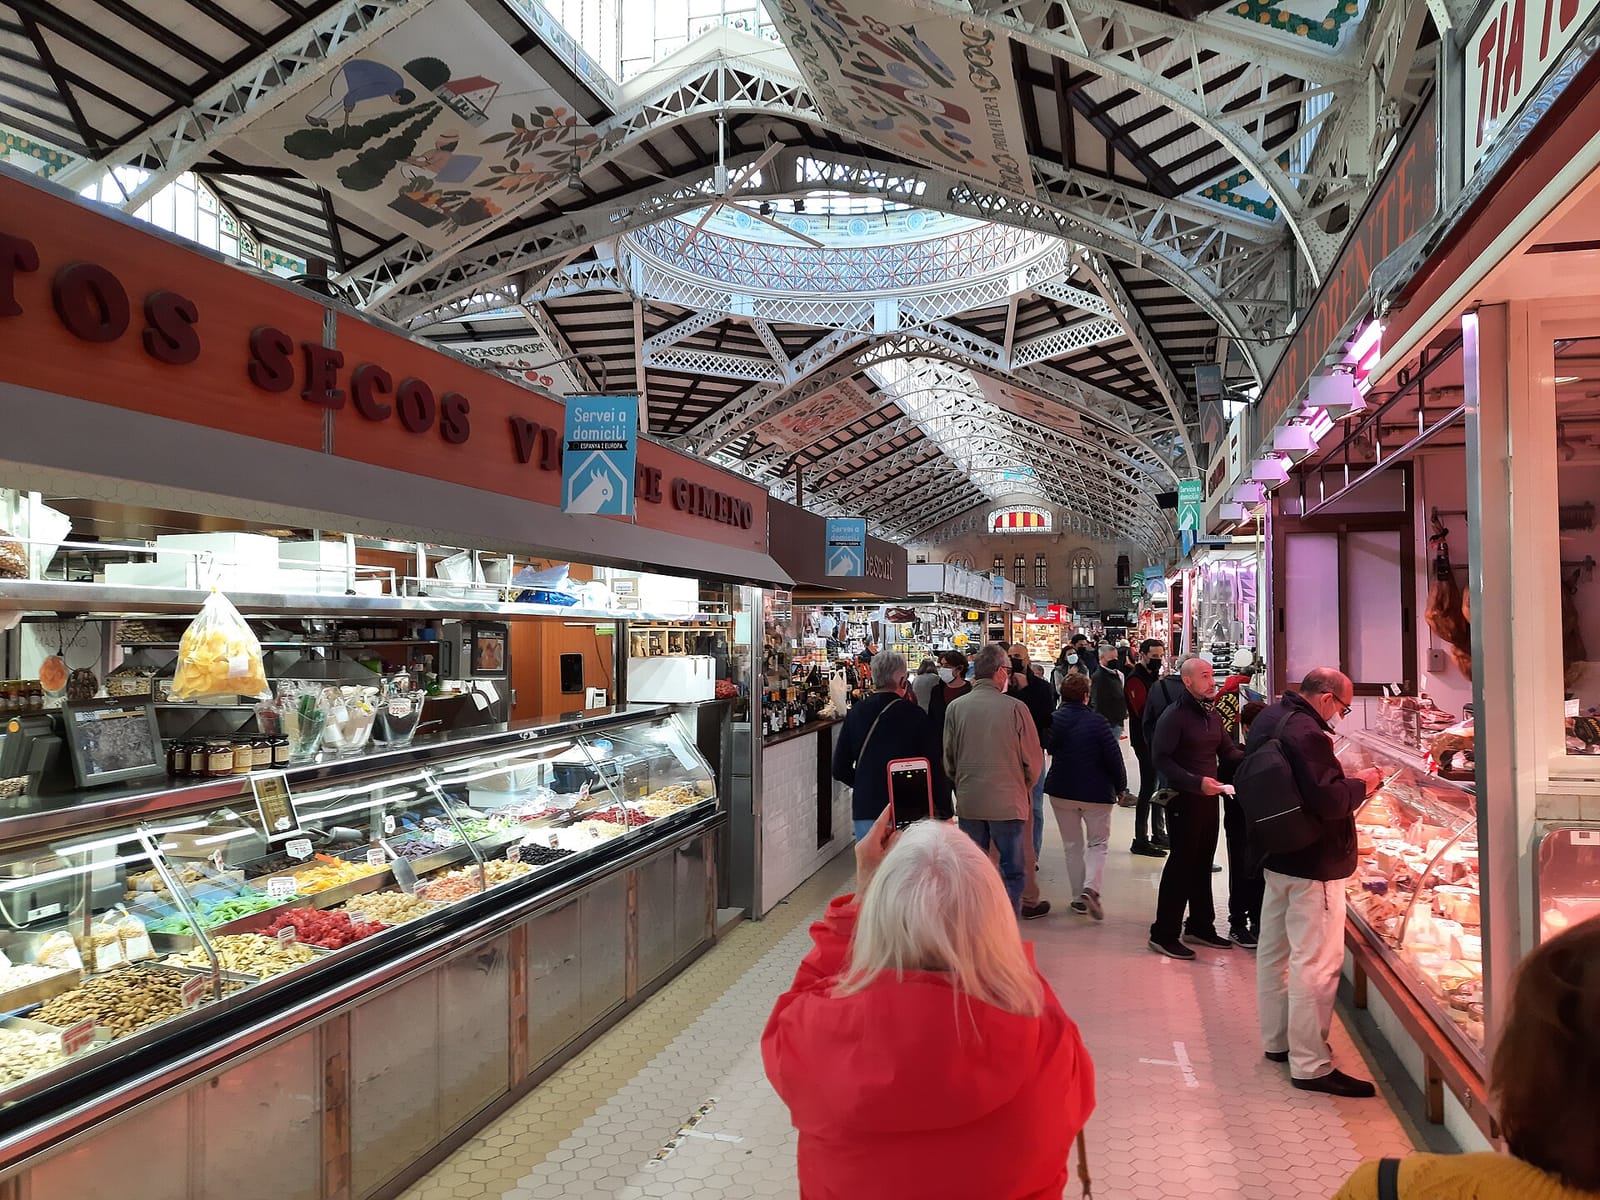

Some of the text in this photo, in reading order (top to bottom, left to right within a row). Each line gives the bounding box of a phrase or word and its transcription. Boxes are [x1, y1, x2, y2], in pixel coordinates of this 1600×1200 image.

[1304, 143, 1417, 378] LORENTE
[248, 326, 471, 444] SECOS
[671, 476, 753, 529] GIMENO
[573, 425, 626, 440] domicili
[574, 407, 627, 423] Servei a
